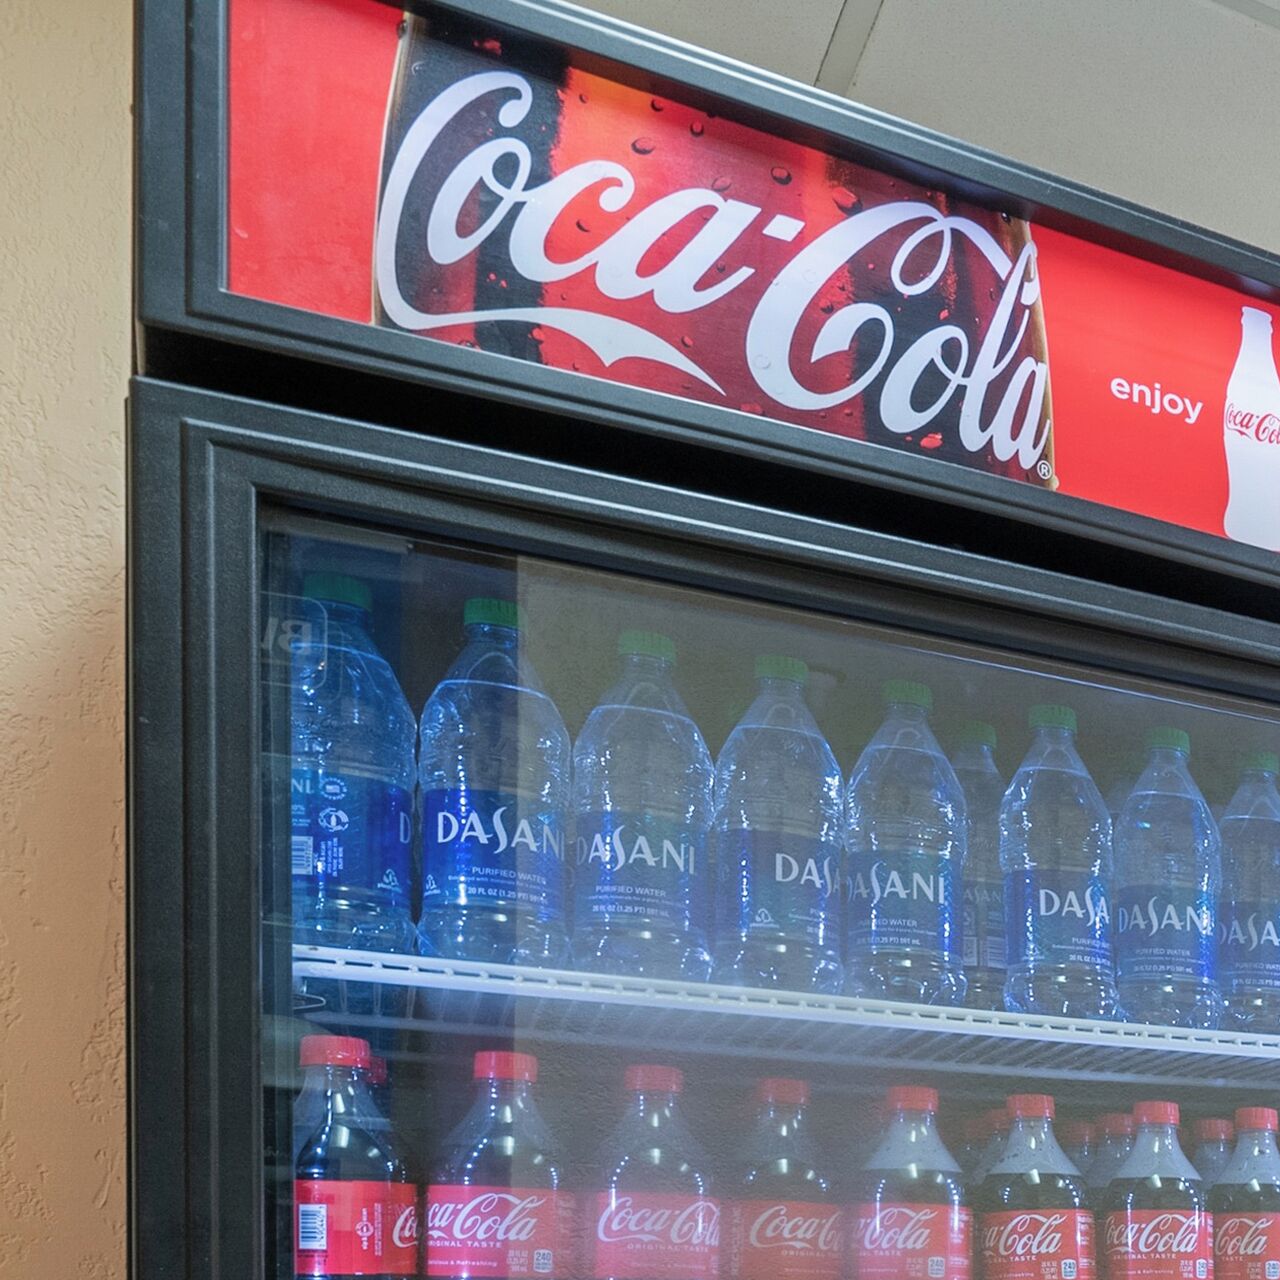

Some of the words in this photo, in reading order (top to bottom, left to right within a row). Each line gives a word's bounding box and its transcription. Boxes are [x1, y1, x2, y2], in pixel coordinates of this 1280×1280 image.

[376, 70, 1053, 471] Coca-Cola
[1110, 376, 1203, 424] enjoy
[437, 806, 565, 861] DASANI
[576, 825, 695, 875] DASANI
[471, 866, 516, 879] PURIFIED
[517, 872, 546, 884] WATER
[595, 885, 633, 895] PURIFIED
[635, 887, 666, 898] WATER
[889, 918, 917, 927] WATER
[467, 1240, 501, 1248] TASTE
[627, 1243, 681, 1251] ORIGINAL
[535, 1252, 551, 1263] 240
